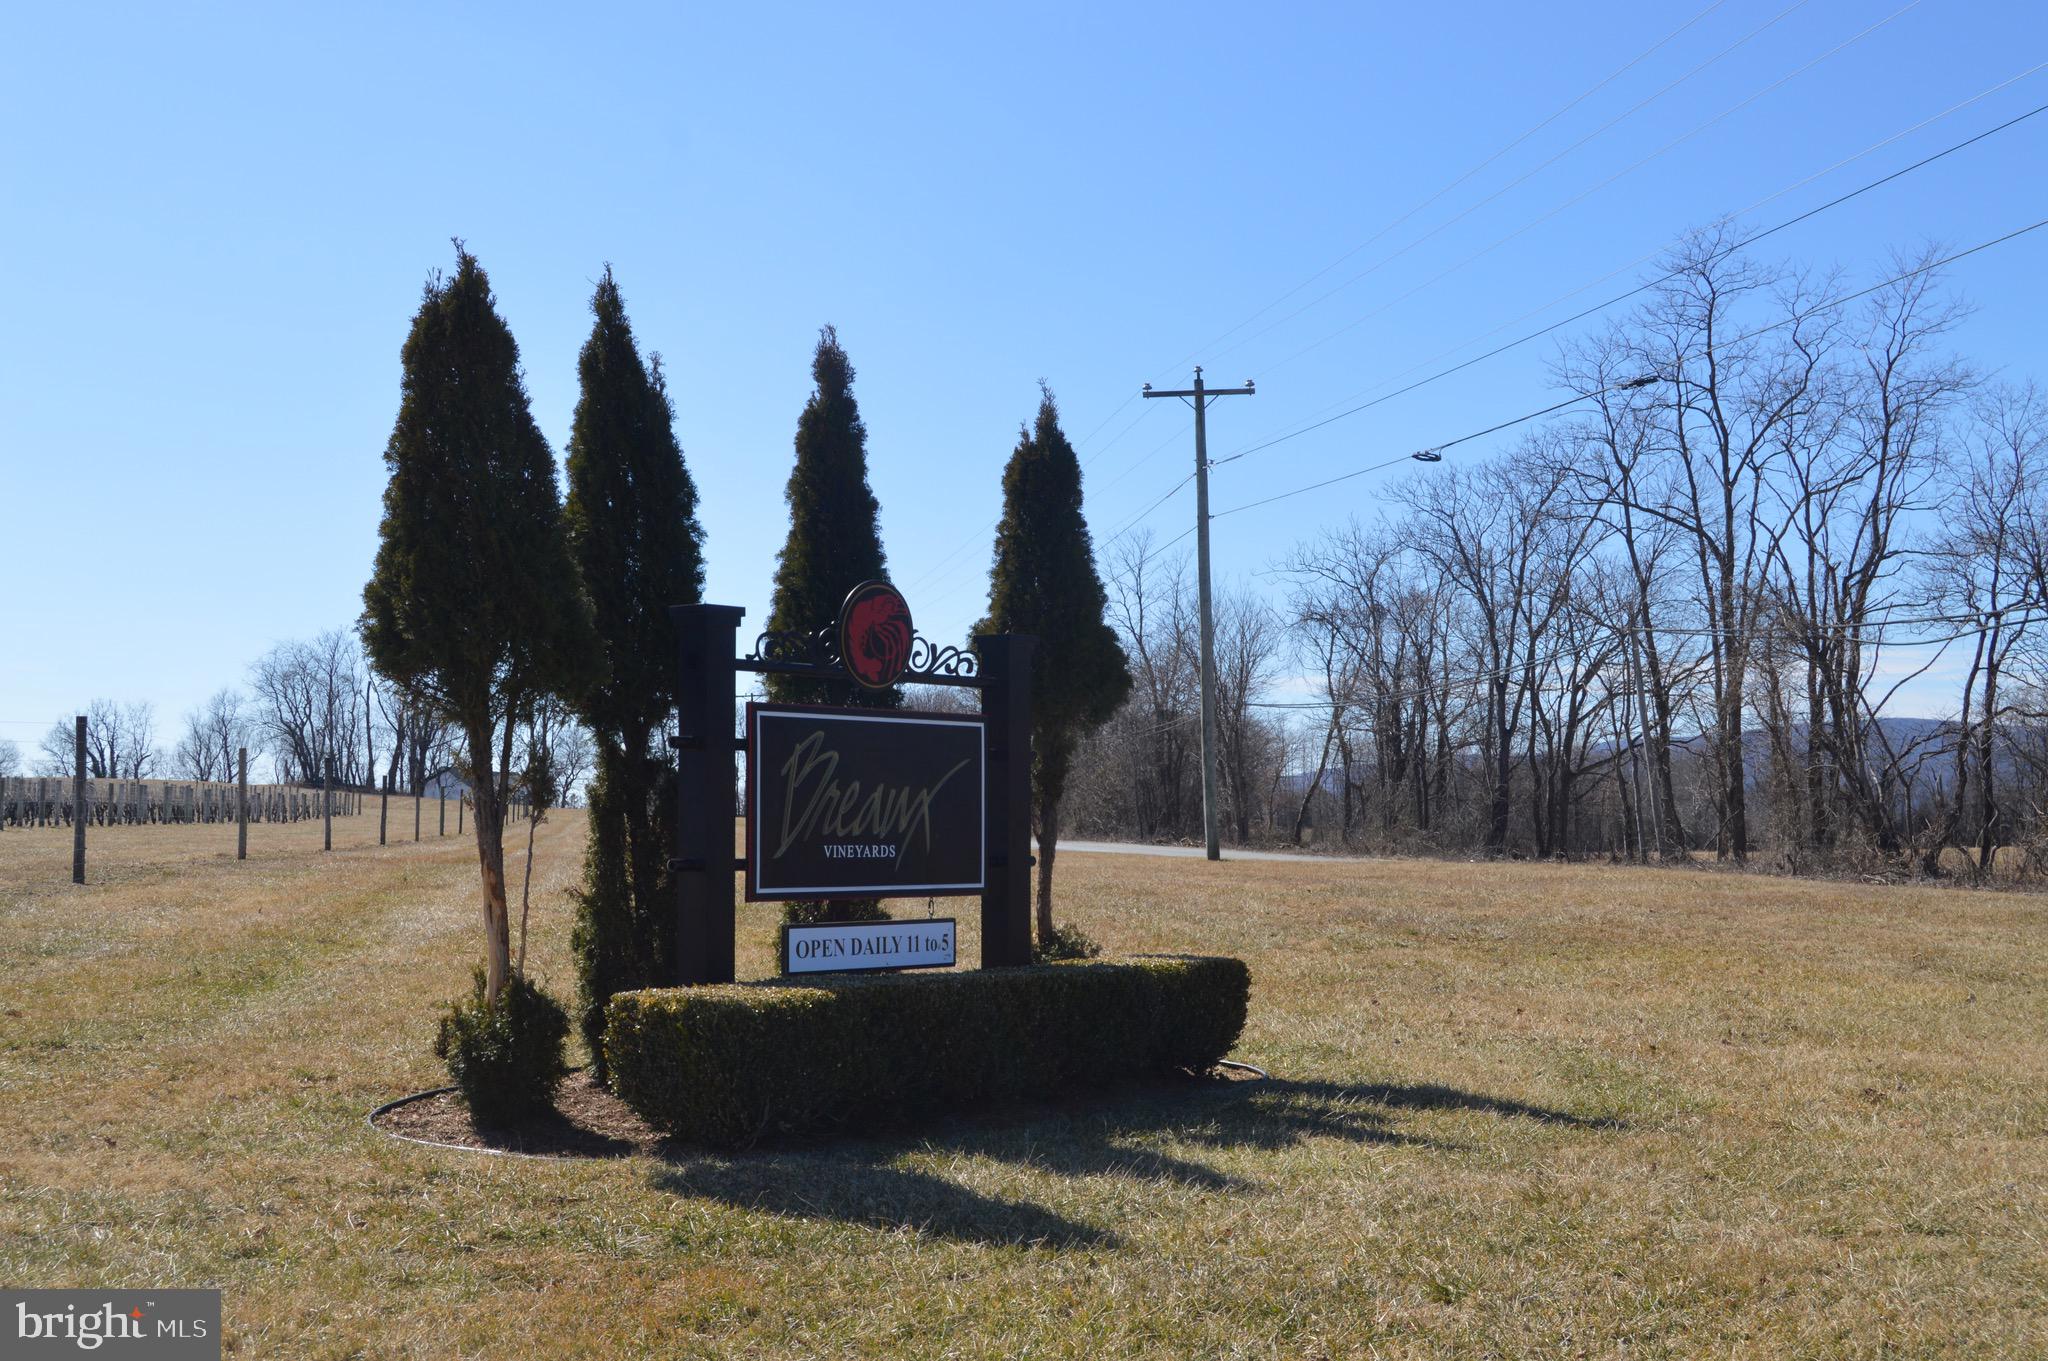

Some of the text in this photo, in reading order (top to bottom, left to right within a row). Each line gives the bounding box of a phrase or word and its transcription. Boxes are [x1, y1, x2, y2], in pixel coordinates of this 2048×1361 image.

[824, 845, 896, 858] VINEYARDS
[796, 933, 949, 959] OPEN DAILY 11 to 5
